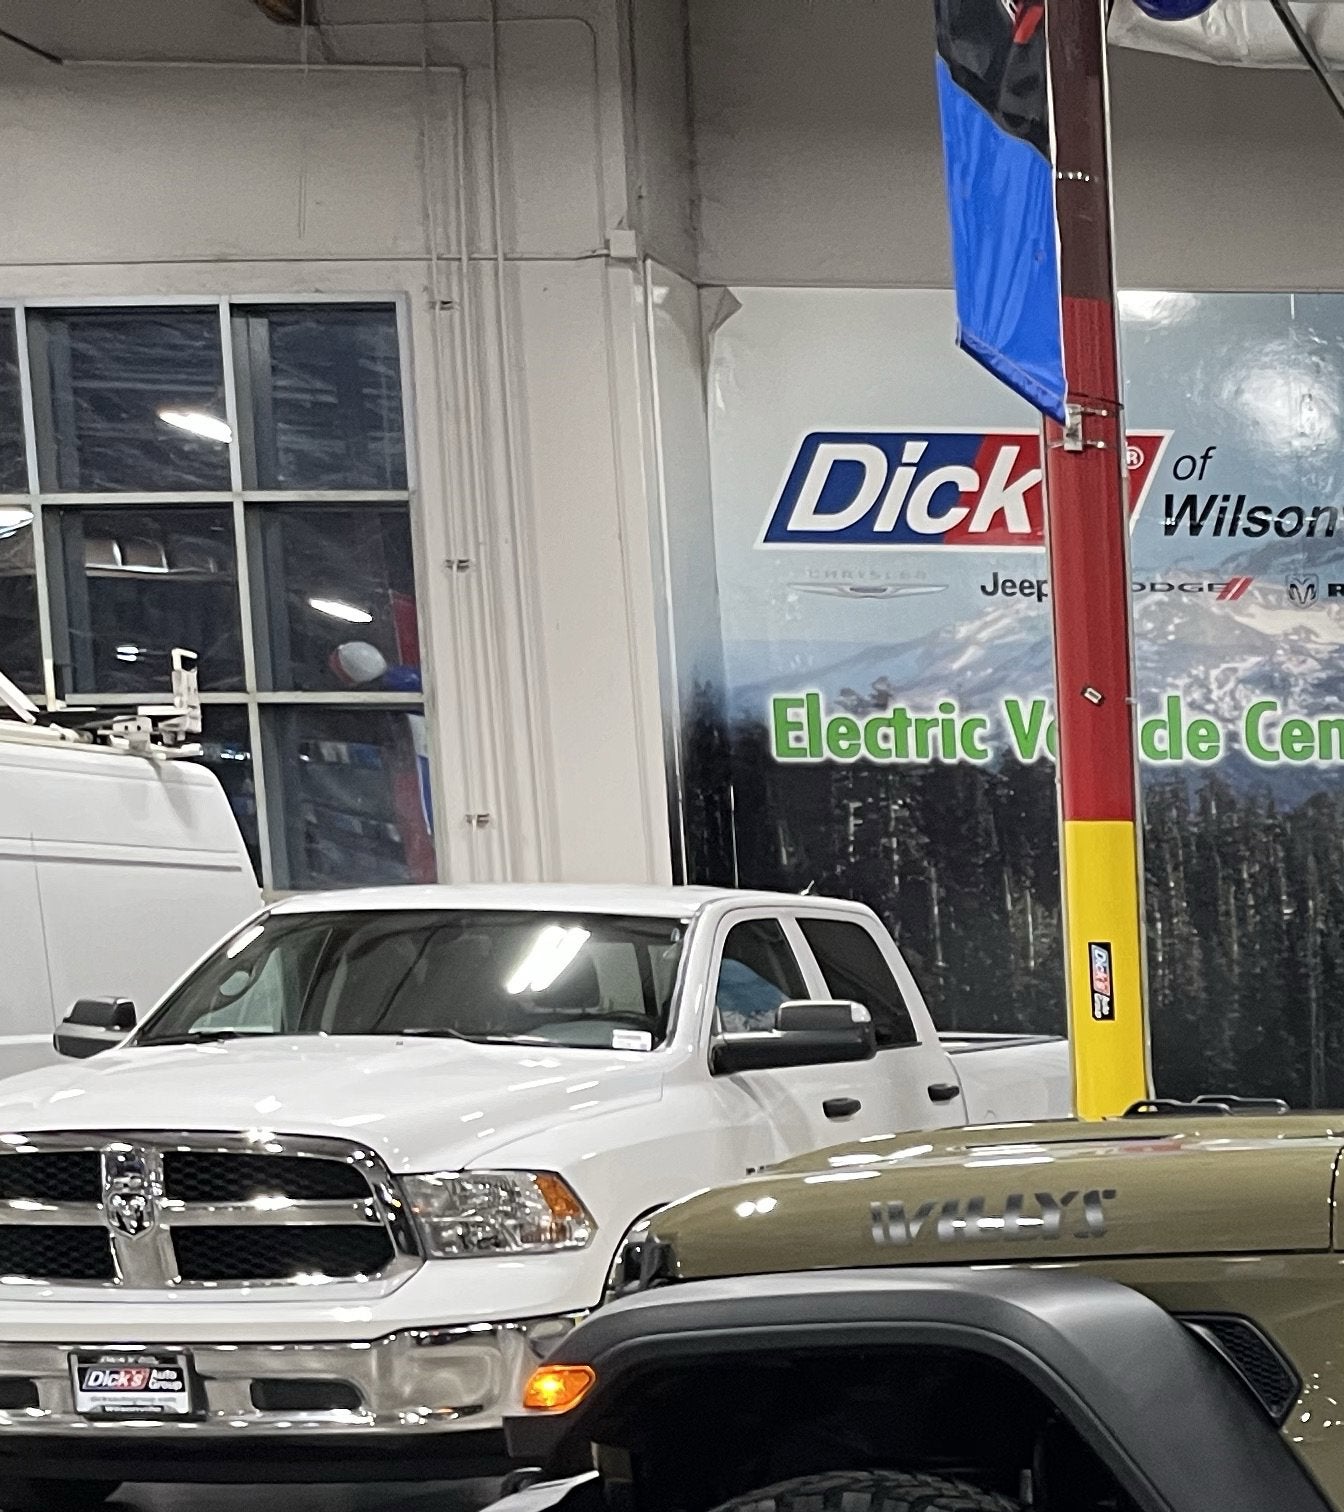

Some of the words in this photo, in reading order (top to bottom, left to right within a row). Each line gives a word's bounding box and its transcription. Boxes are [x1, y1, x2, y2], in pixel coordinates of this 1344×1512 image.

[786, 441, 1043, 534] Dick
[1172, 446, 1216, 481] of
[1131, 582, 1229, 593] ODGE
[772, 692, 989, 760] Electric
